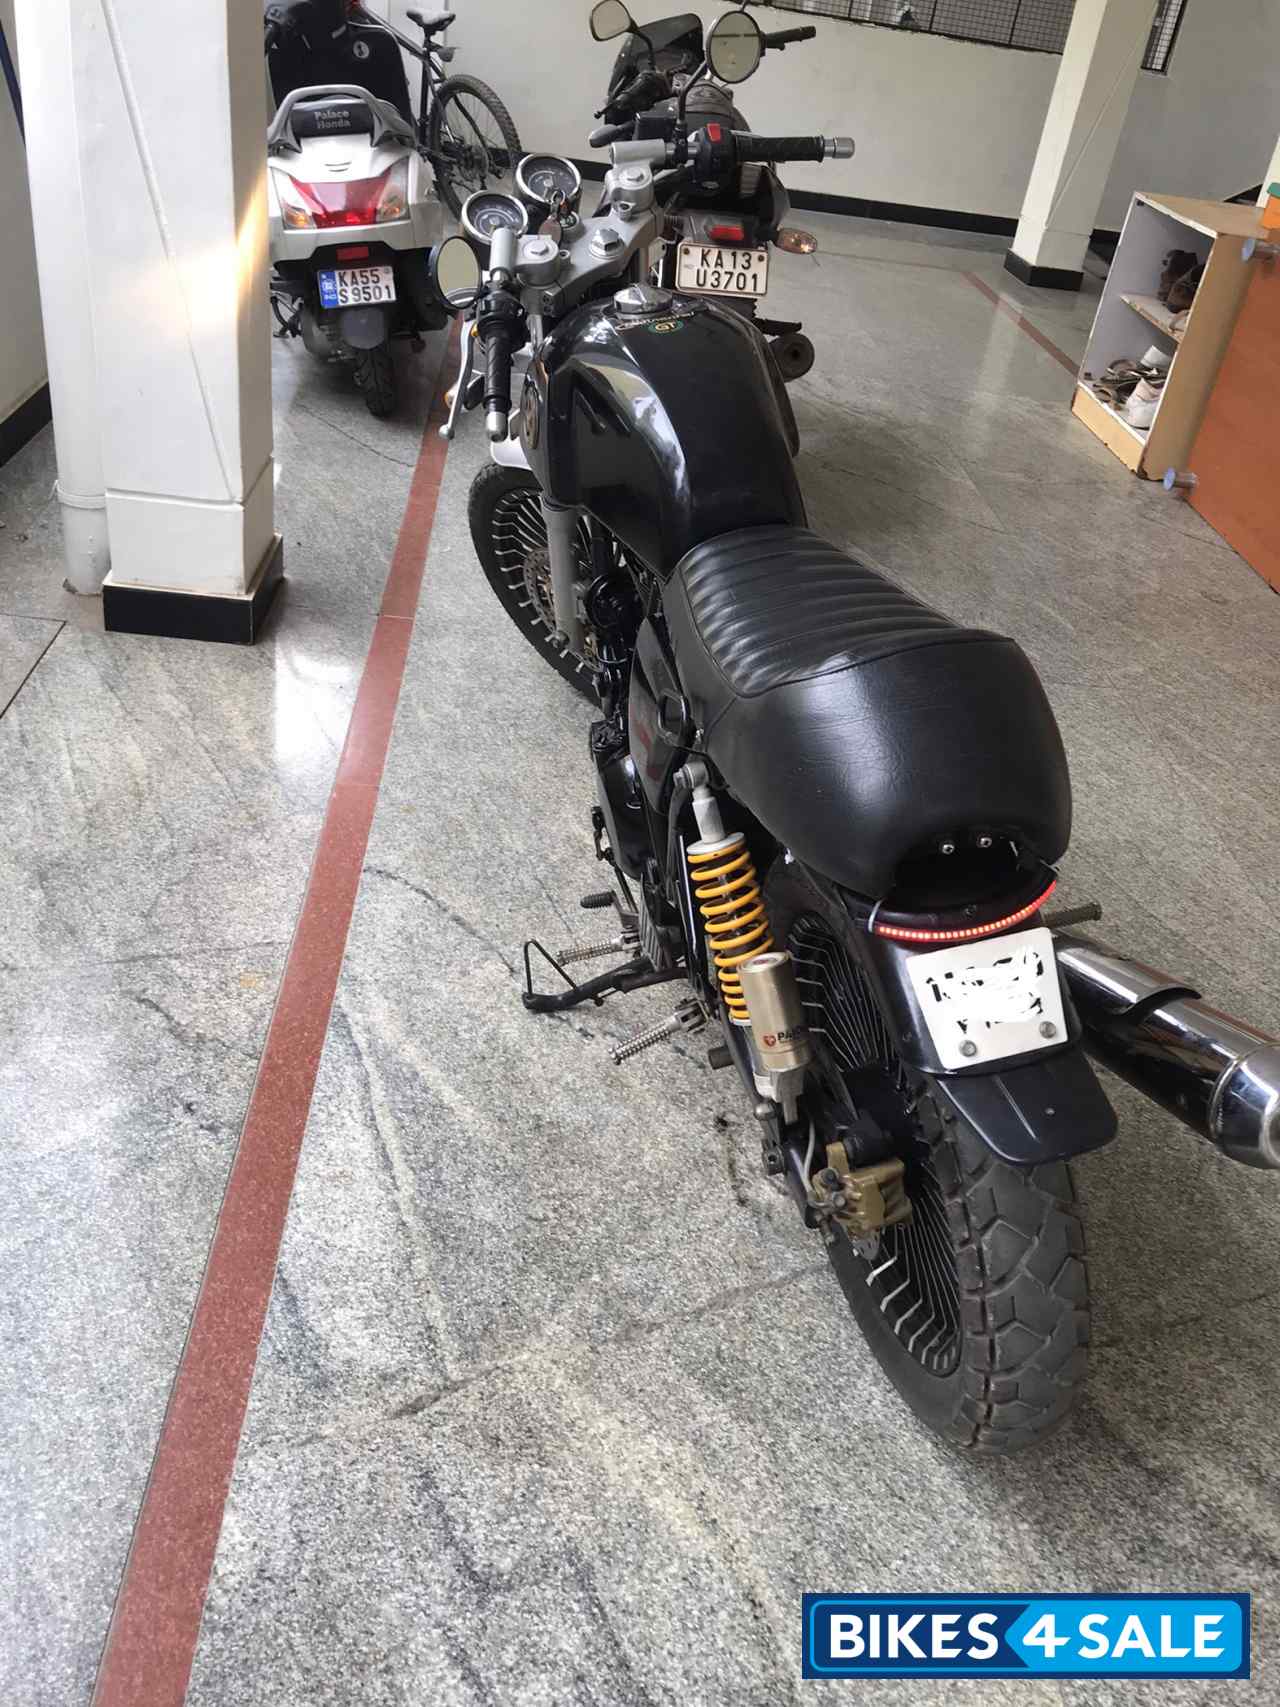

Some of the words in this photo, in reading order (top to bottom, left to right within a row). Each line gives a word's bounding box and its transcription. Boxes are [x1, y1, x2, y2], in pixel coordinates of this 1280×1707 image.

[313, 110, 350, 121] Palace
[316, 119, 351, 129] Honda
[696, 269, 758, 292] U3701
